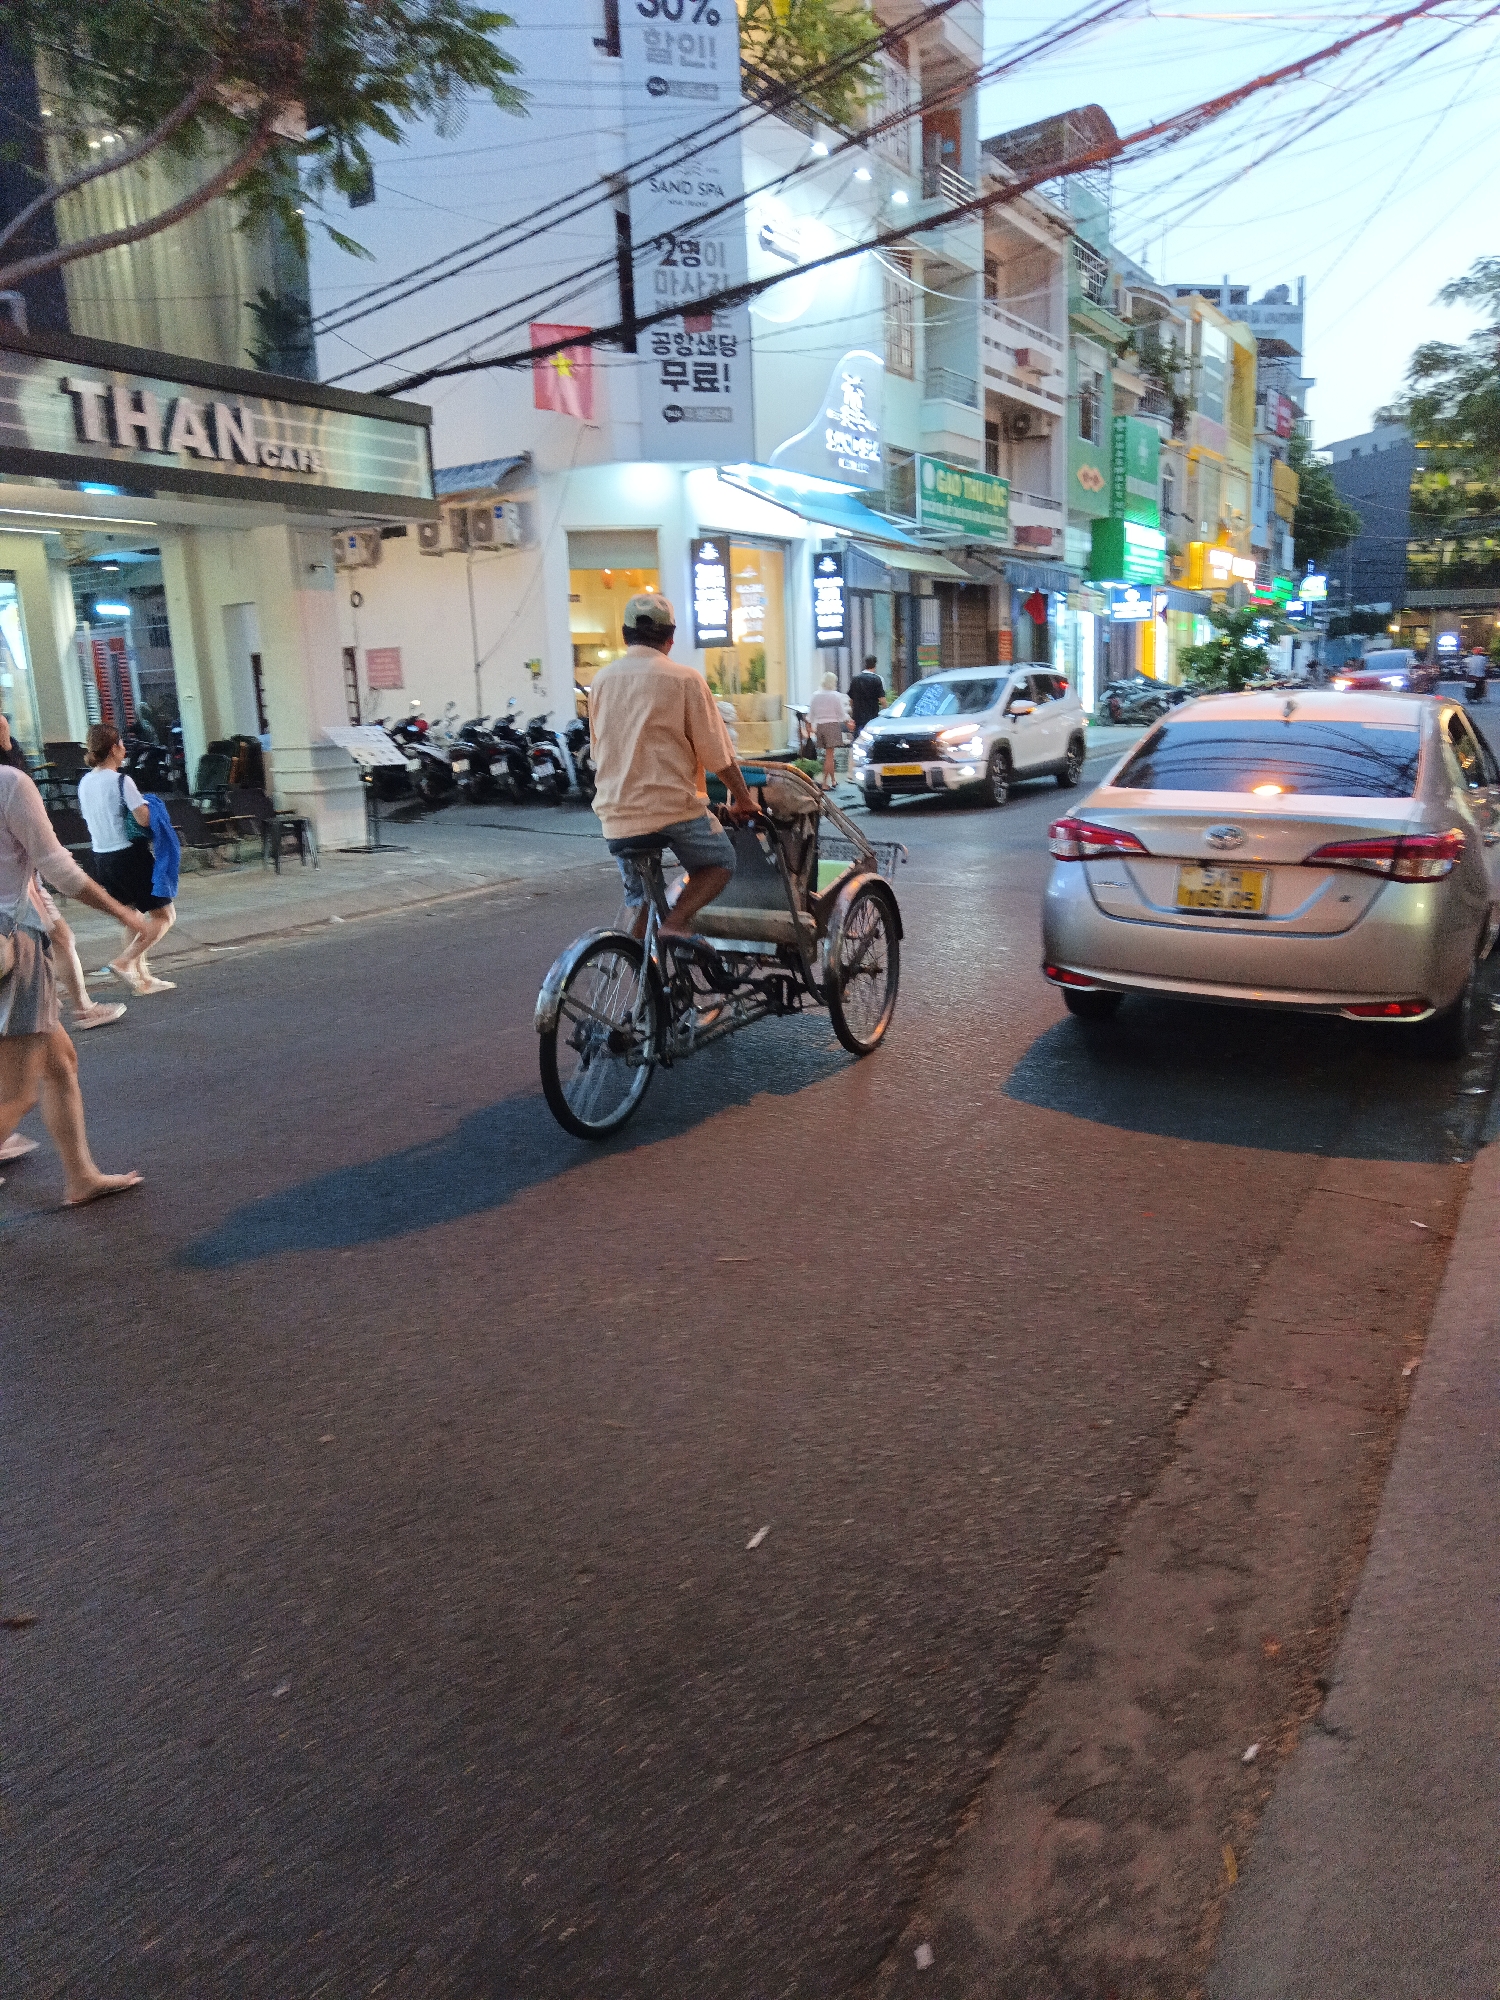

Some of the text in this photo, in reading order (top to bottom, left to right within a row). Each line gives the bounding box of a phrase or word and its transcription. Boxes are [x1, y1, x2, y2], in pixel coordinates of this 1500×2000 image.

[643, 28, 717, 69] 할인!
[649, 177, 725, 198] SAND SPA
[660, 360, 731, 393] 무료!
[60, 376, 259, 465] THAN
